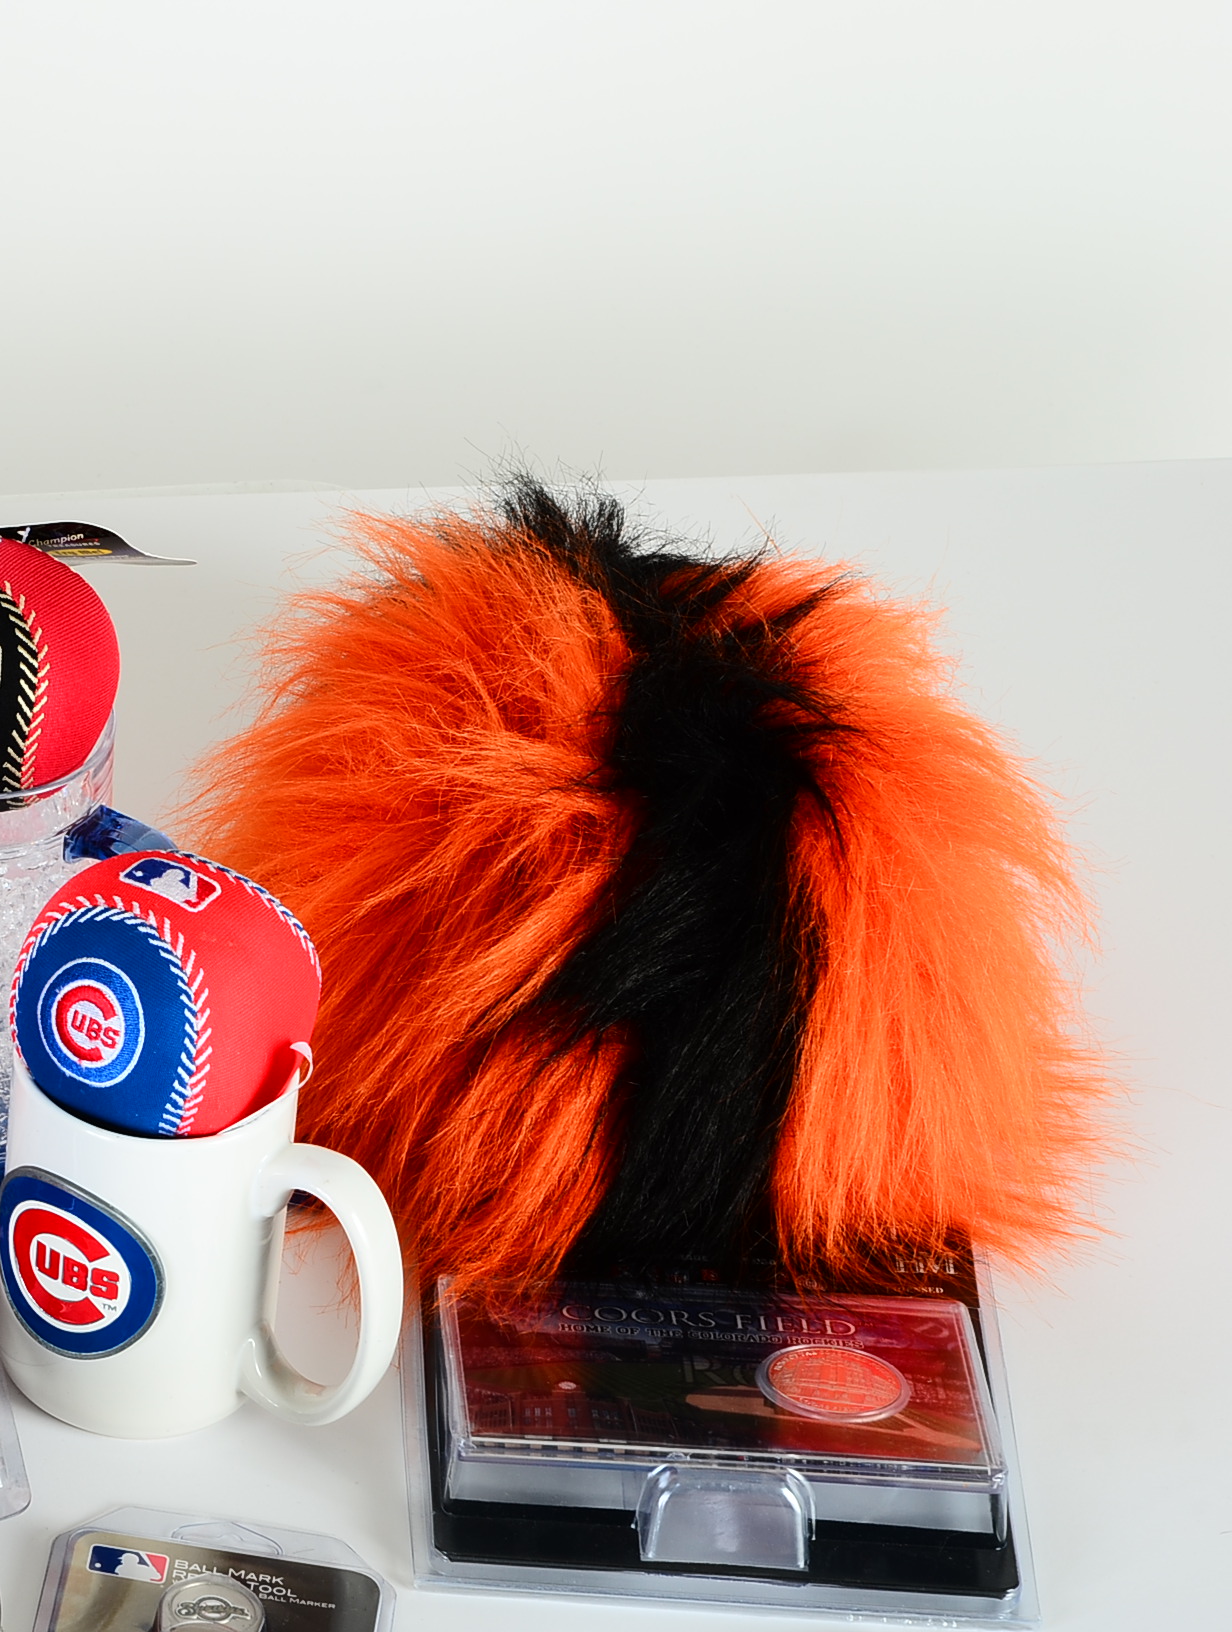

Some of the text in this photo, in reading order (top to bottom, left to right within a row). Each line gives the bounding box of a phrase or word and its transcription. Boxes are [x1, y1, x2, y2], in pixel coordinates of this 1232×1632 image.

[28, 533, 84, 547] Champion
[561, 1304, 856, 1336] COORS FIELD
[558, 1322, 865, 1349] HOME OF THE COLORADO ROCKIES
[174, 1559, 222, 1576] BALL
[228, 1568, 285, 1585] MARK
[246, 1581, 297, 1598] TOOL
[258, 1593, 336, 1609] BALL MARKER
